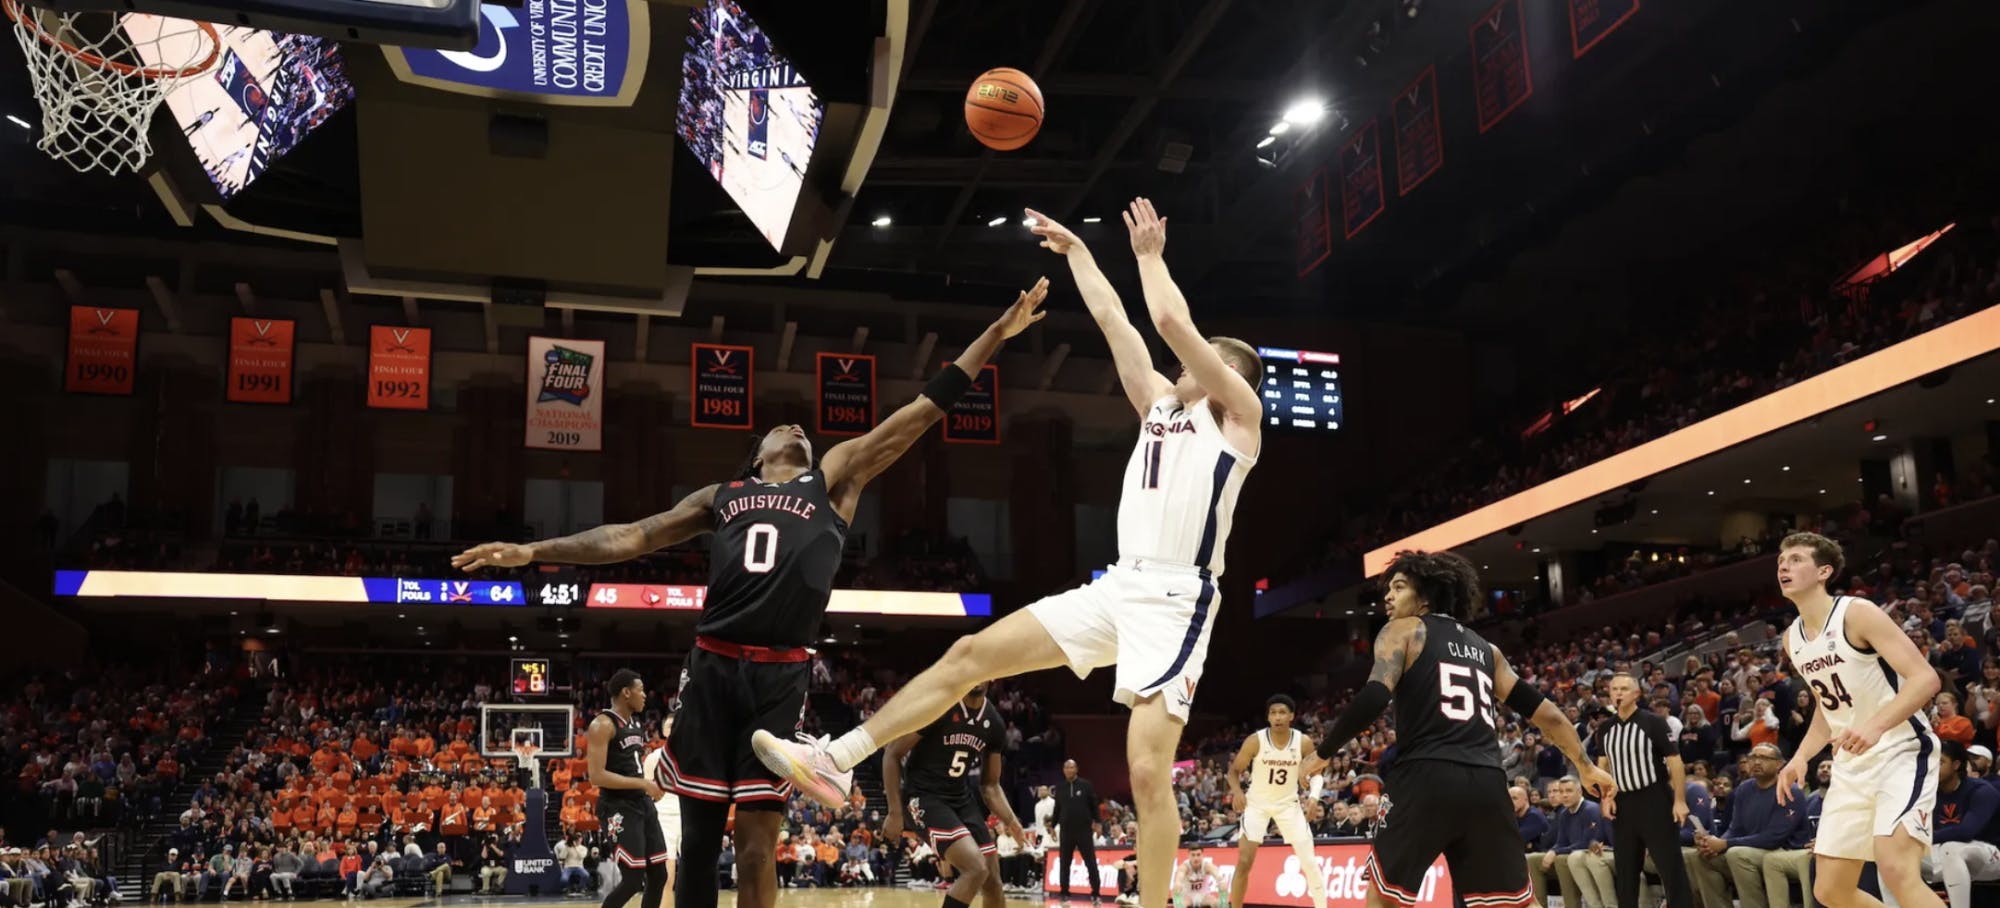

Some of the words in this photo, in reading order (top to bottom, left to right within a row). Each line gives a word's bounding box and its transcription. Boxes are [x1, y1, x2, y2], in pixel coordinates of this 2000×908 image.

[529, 0, 544, 19] VIR
[530, 21, 545, 36] OF
[532, 36, 547, 86] UNIVERSITY
[583, 40, 606, 92] CREDIT
[730, 65, 806, 88] VIRGINIA
[74, 347, 100, 357] FINAL
[102, 349, 129, 359] FOUR
[235, 358, 262, 367] FINAL
[263, 360, 287, 369] FOUR
[374, 366, 400, 375] FINAL
[402, 367, 424, 376] FOUR
[548, 362, 587, 377] FINAL
[76, 363, 127, 383] 1990
[238, 373, 280, 392] 1991
[376, 380, 420, 398] 1992
[545, 376, 584, 389] FOUR
[700, 384, 722, 393] FINAL
[723, 385, 744, 394] FOUR
[536, 409, 592, 420] NATIONAL
[703, 399, 741, 416] 1981
[828, 406, 866, 424] 1984
[953, 414, 991, 430] 2019
[548, 431, 580, 445] 2019
[720, 495, 816, 523] LOUISVILLE
[744, 523, 778, 573] 0
[403, 581, 420, 590] TOL
[490, 586, 513, 601] 64
[540, 584, 578, 600] 4:51
[668, 588, 683, 596] TOL
[402, 591, 430, 600] FOULS
[595, 588, 617, 604] 45
[666, 598, 693, 606] FOULS
[1448, 642, 1485, 666] CLARK
[522, 663, 545, 674] 4:51
[530, 674, 542, 692] 8
[1440, 662, 1496, 730] 55
[1811, 673, 1853, 711] 34
[634, 750, 643, 774] 1
[948, 750, 969, 778] 5
[1269, 768, 1288, 785] 13
